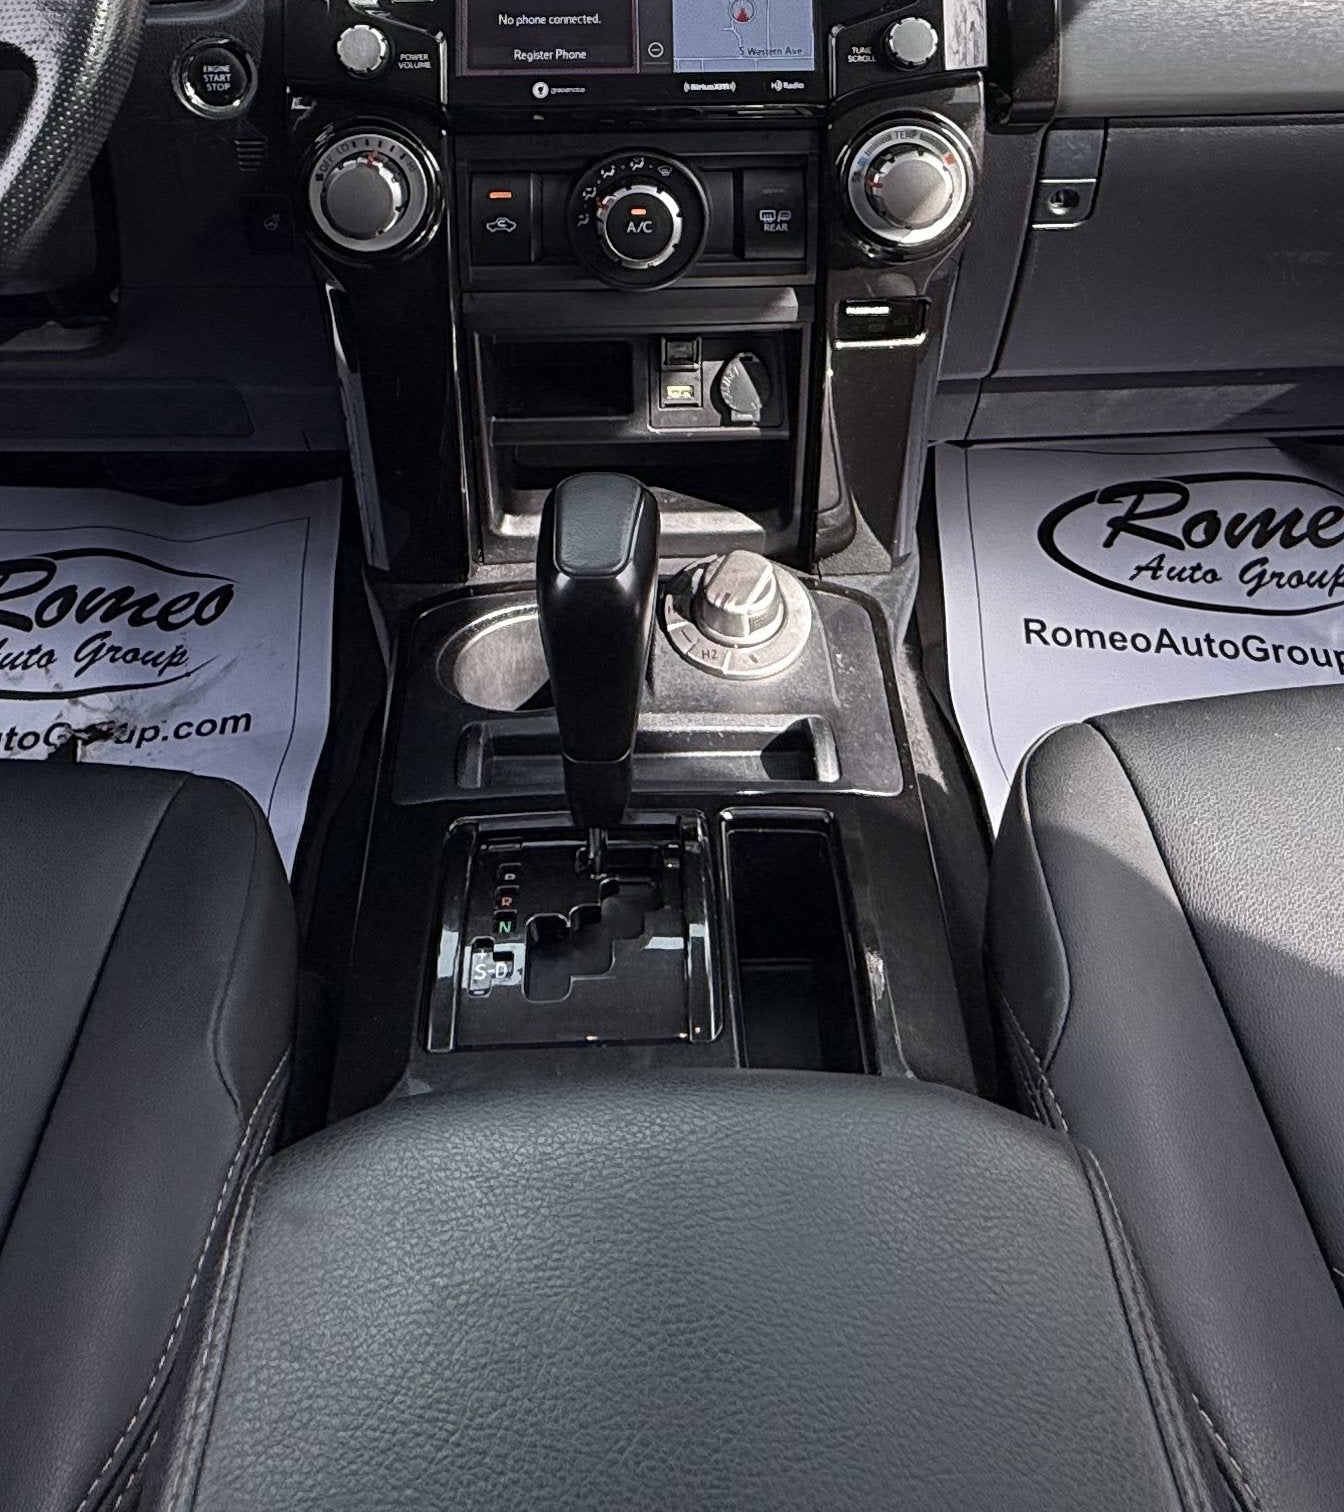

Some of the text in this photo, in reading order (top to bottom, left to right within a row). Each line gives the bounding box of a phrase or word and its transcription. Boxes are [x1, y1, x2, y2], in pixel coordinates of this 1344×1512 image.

[498, 13, 602, 27] No phone connected.
[399, 53, 429, 62] POWER
[513, 48, 587, 63] Register Phone
[784, 46, 803, 55] Ave
[203, 73, 232, 83] START
[206, 82, 231, 92] STOP
[319, 154, 335, 173] OFF
[626, 220, 654, 234] A/C
[763, 222, 789, 232] REAR
[1128, 553, 1222, 585] Auto
[74, 630, 192, 677] Group
[701, 648, 719, 661] H2
[498, 920, 512, 934] N
